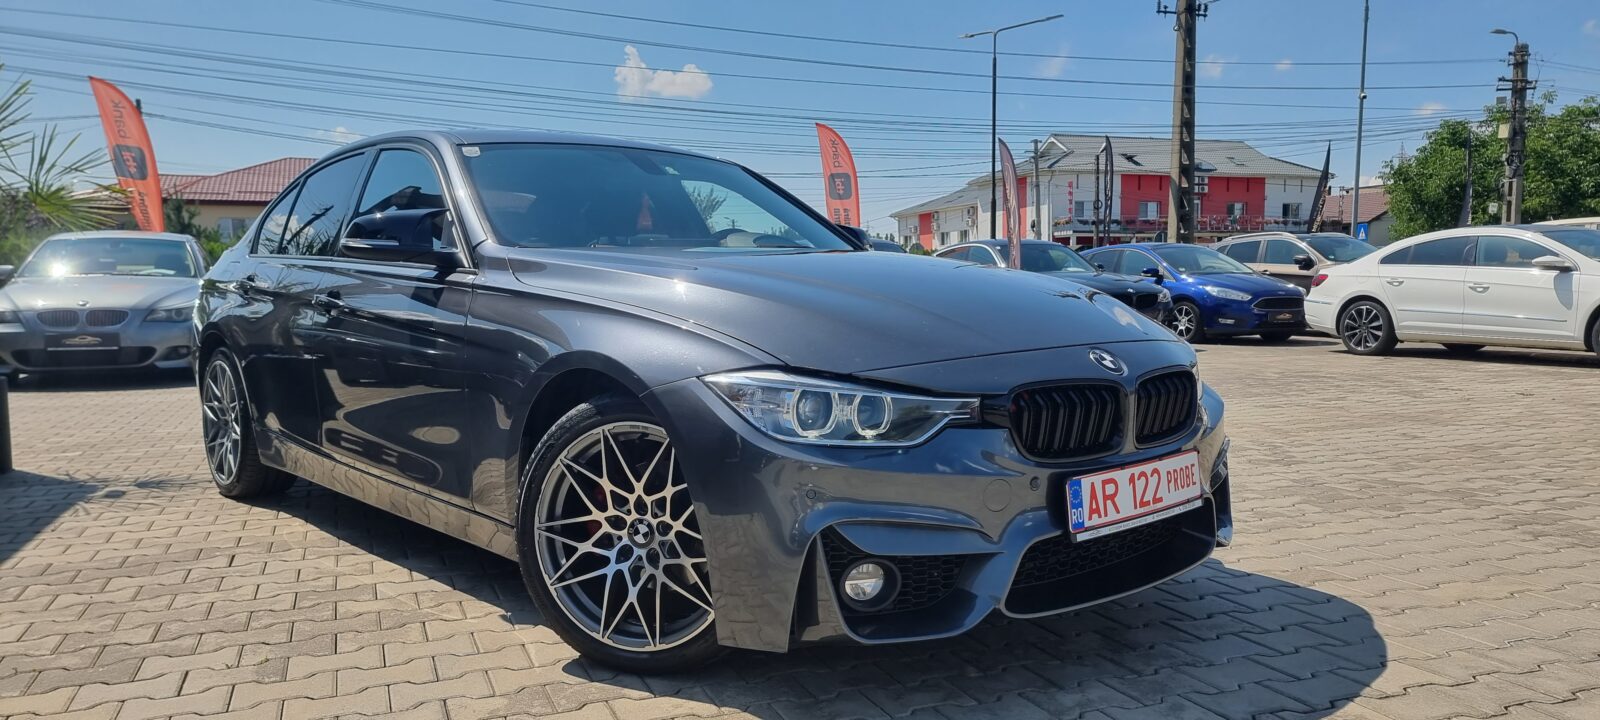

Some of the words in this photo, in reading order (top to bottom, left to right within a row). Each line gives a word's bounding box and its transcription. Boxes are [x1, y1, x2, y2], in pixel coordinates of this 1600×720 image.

[1087, 478, 1120, 521] AR
[1129, 467, 1163, 509] 122
[1166, 463, 1196, 493] PROBE
[1072, 507, 1084, 525] RO
